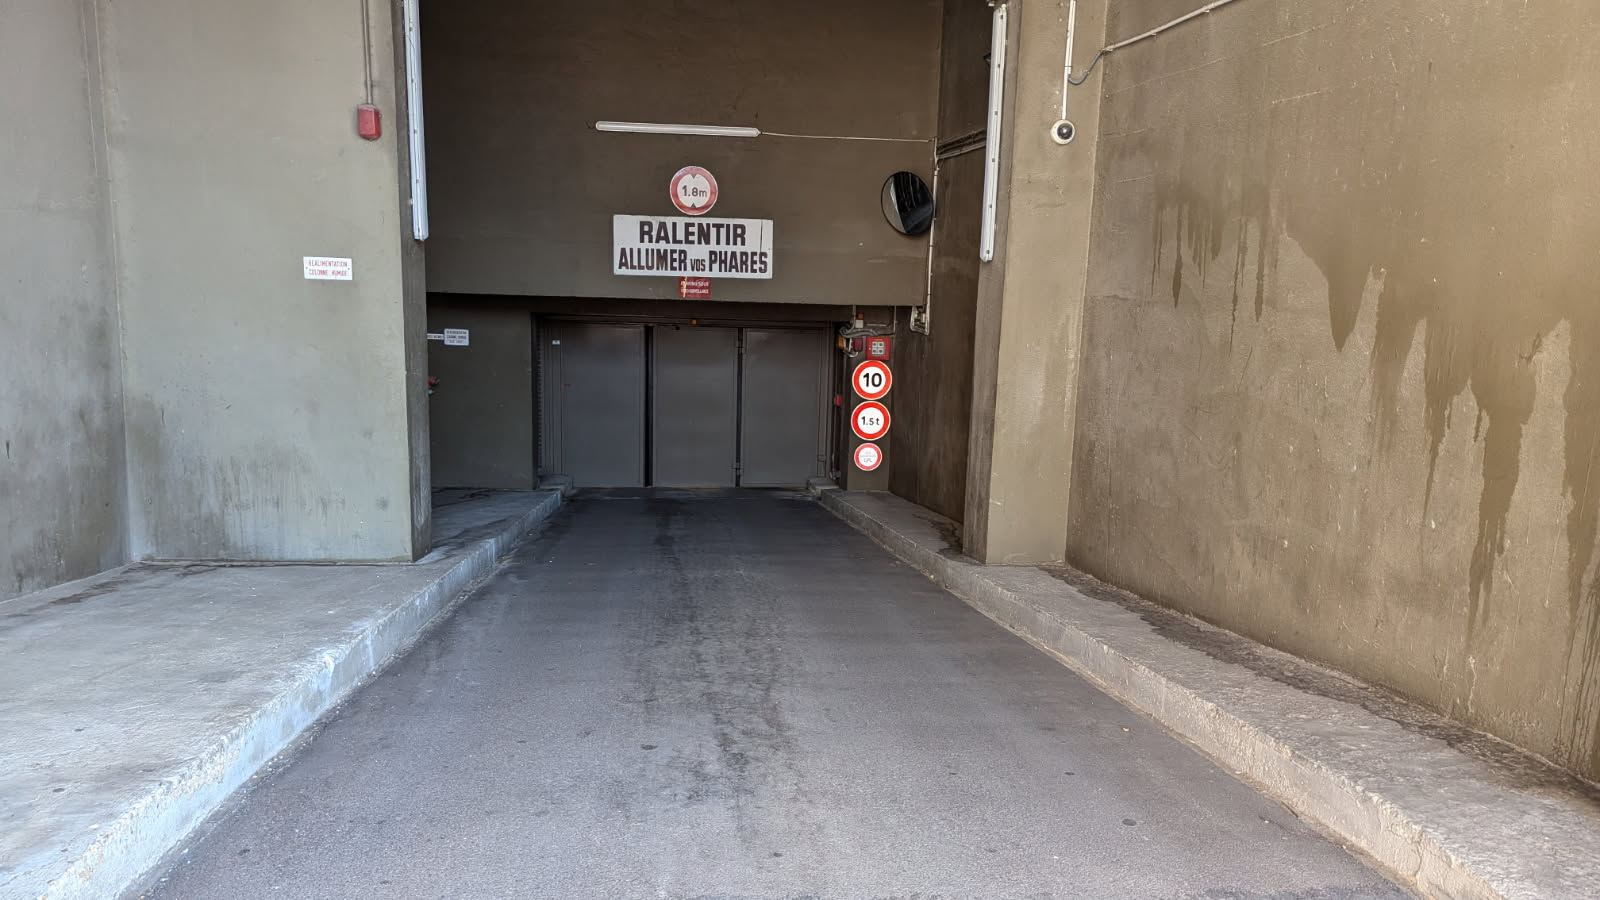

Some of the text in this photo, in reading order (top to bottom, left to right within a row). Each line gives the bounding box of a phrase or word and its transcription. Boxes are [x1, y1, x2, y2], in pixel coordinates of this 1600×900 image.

[639, 221, 746, 246] RALENTIR
[618, 247, 768, 274] ALLUMER VOS PHARES
[863, 373, 882, 387] 10
